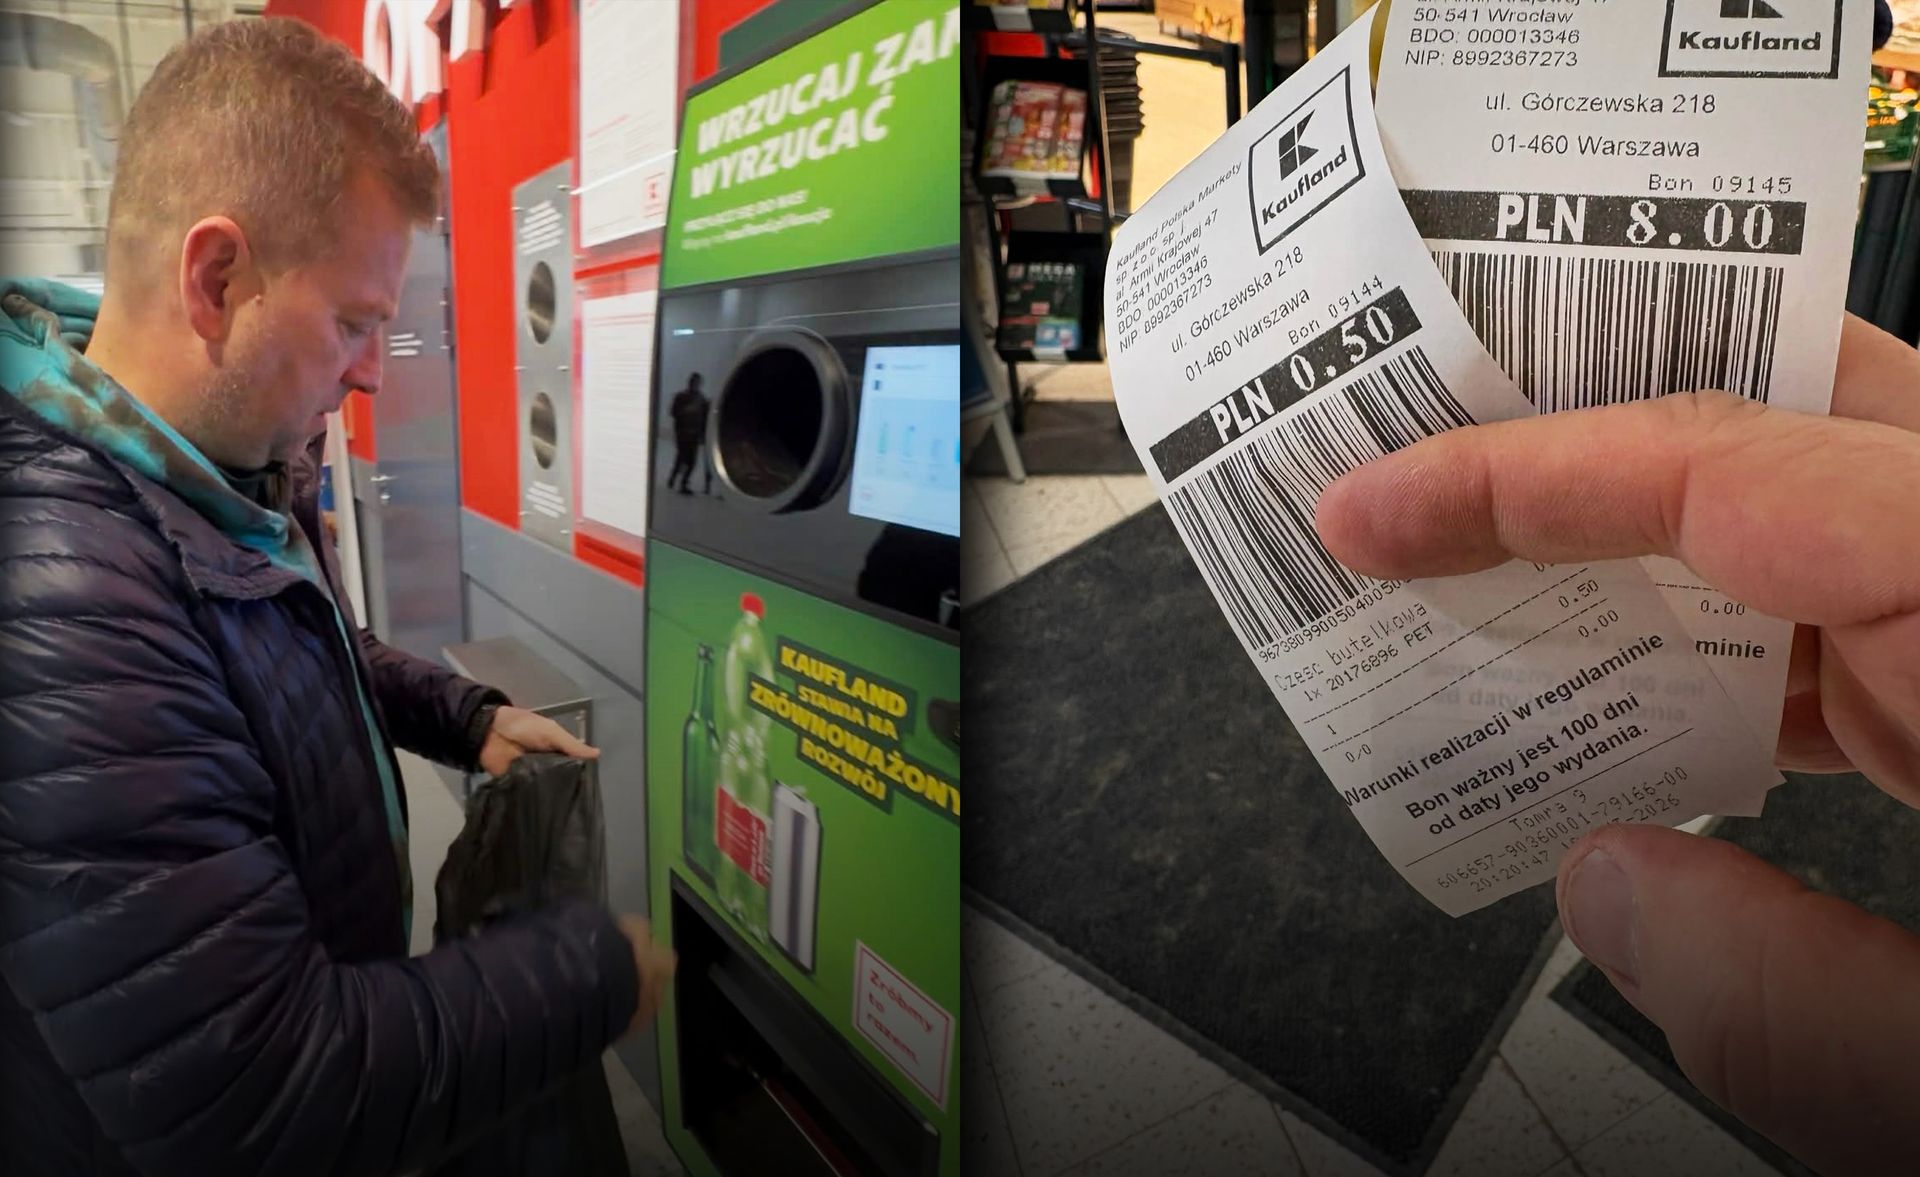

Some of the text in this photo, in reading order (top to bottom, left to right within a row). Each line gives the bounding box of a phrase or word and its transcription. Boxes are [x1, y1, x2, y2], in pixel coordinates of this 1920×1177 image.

[1413, 8, 1574, 23] 50-541 Wrocław
[1467, 28, 1580, 44] 000013346
[1679, 31, 1822, 50] Kaufland
[1405, 50, 1578, 66] NIP: 8992367273
[698, 51, 863, 154] WRZUCAJ
[1486, 92, 1716, 113] ul. Górczewska 218
[691, 79, 895, 198] WYRZUCAĆ
[1491, 134, 1700, 157] 01-460 Warszawa
[1116, 161, 1242, 270] Kaufland Polska Markety
[1262, 144, 1348, 225] Kaufland
[1649, 174, 1793, 194] Bon 09145
[1130, 266, 1154, 291] Armii
[1157, 223, 1202, 267] Krajowej
[1204, 208, 1219, 227] 47
[1496, 194, 1774, 249] PLN 8.00
[1116, 244, 1201, 318] 50-541 Wrocław
[1144, 273, 1213, 334] 8992367273
[1147, 255, 1209, 310] 000013346
[1171, 246, 1304, 353] ul. Górczewska 218
[1288, 275, 1383, 346] Bon 09144
[1185, 288, 1311, 382] 01-460 Warszawa
[1209, 305, 1394, 444] PLN 0.50
[1558, 579, 1600, 609] 0.50
[1700, 599, 1746, 616] 0.00
[780, 645, 908, 718] KAUFLAND
[1303, 687, 1323, 702] 1x
[1326, 644, 1399, 692] 20176896
[1403, 621, 1434, 648] PET
[1345, 609, 1620, 763] 0/0 0.00
[798, 684, 899, 741] STAWIA NA
[1421, 712, 1511, 771] realizacji
[1511, 702, 1534, 721] w
[1534, 633, 1665, 713] regulaminie
[801, 737, 886, 801] ROZWÓJ
[1405, 788, 1451, 820] Bon
[1451, 757, 1516, 798] ważny
[1515, 734, 1557, 769] jest
[1560, 712, 1599, 743] 100
[1602, 691, 1641, 721] dni
[1428, 723, 1649, 837] od daty jego wydania.
[1470, 850, 1550, 893] 20:20:47
[868, 992, 885, 1014] to
[870, 969, 934, 1033] Zróbmy
